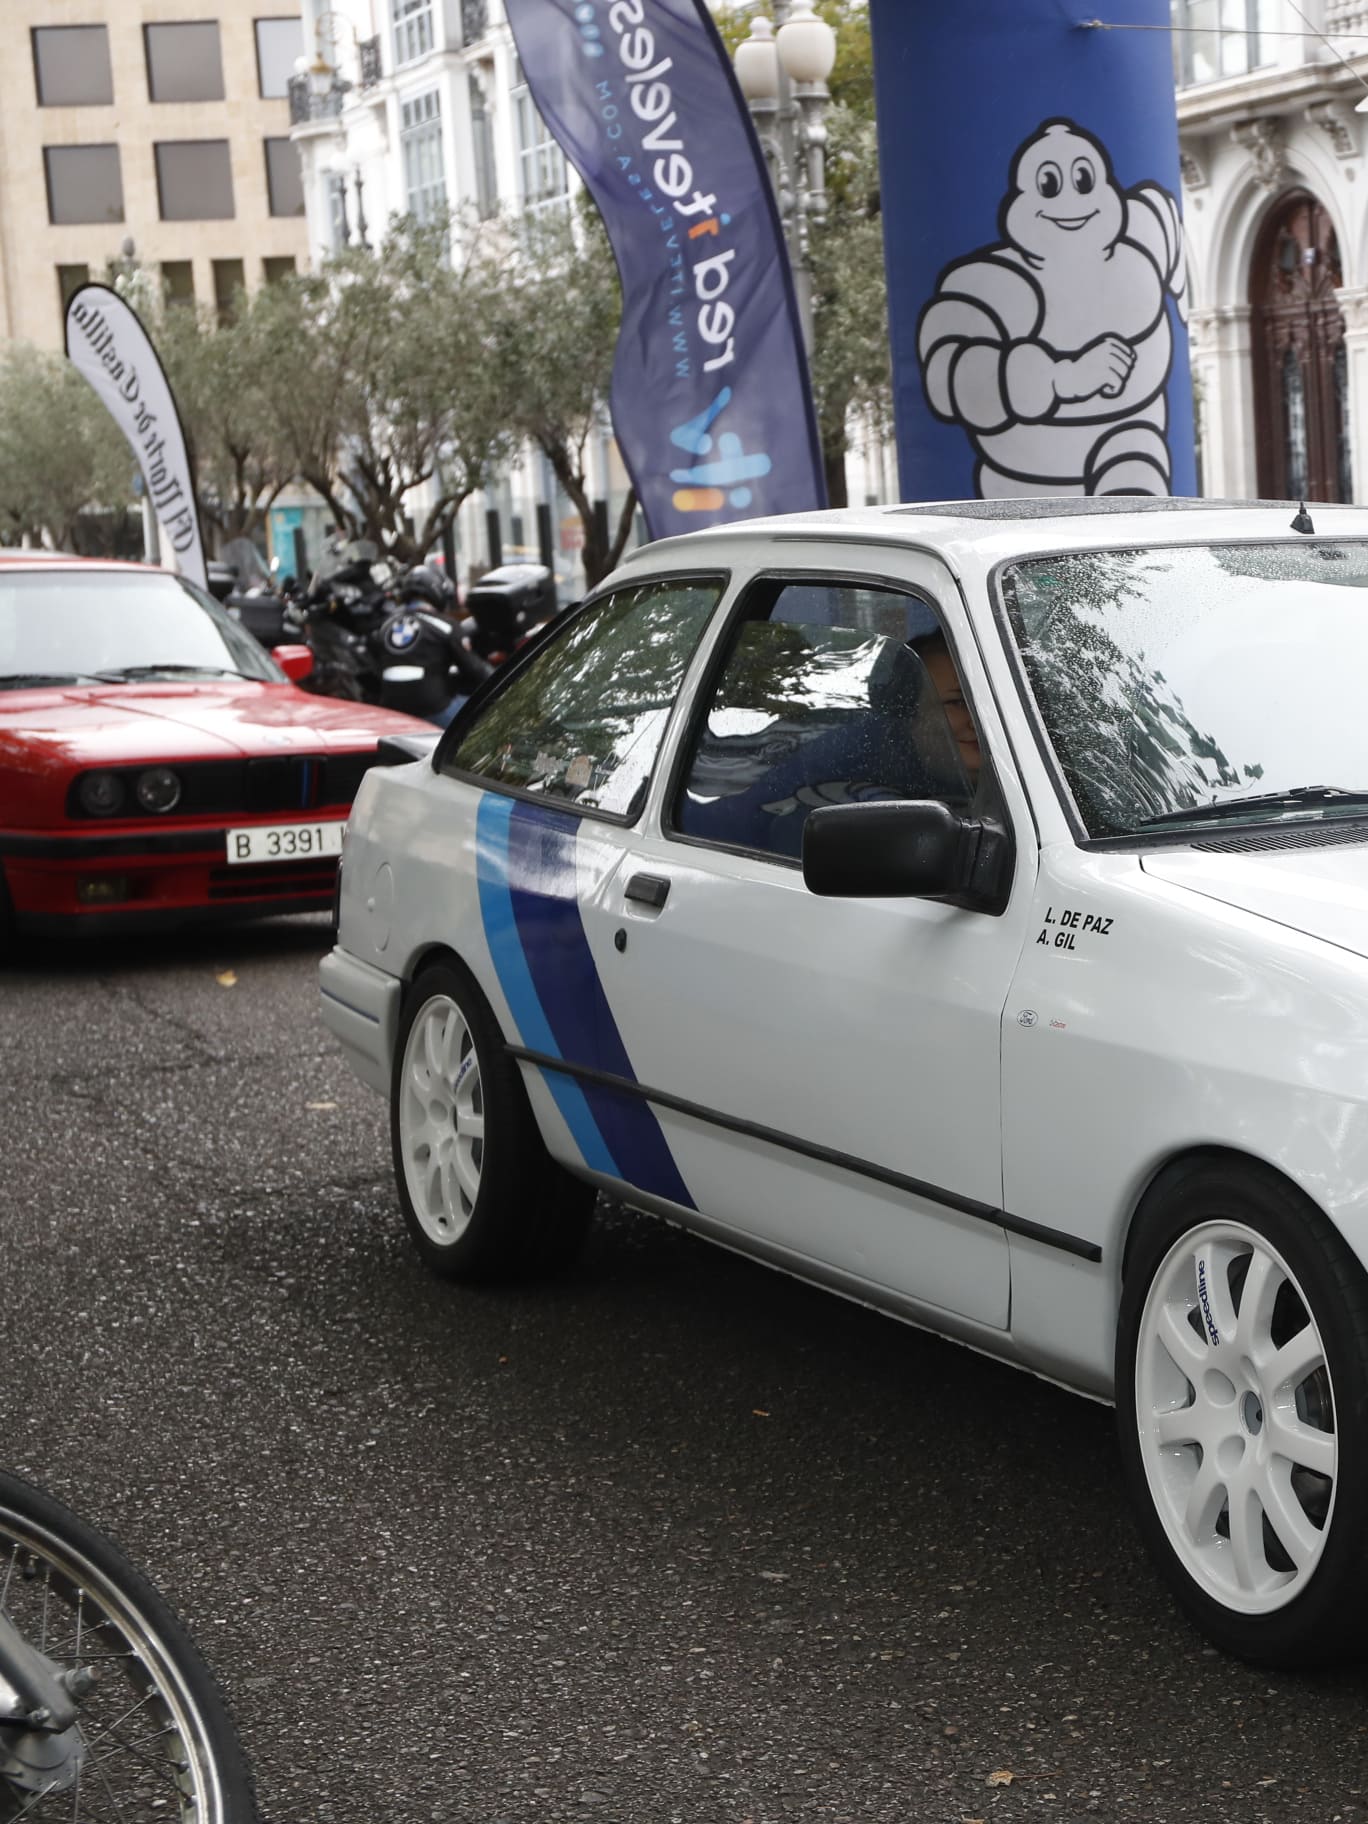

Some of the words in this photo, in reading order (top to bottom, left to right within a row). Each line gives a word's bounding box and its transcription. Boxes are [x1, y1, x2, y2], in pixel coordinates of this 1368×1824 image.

[236, 834, 251, 858] B
[267, 828, 323, 855] 3391
[1044, 906, 1056, 924] L.
[1060, 910, 1082, 928] DE
[1082, 914, 1114, 935] PAZ
[1036, 929, 1049, 945] A.
[1054, 931, 1075, 950] GIL
[1198, 1260, 1220, 1346] speedline
